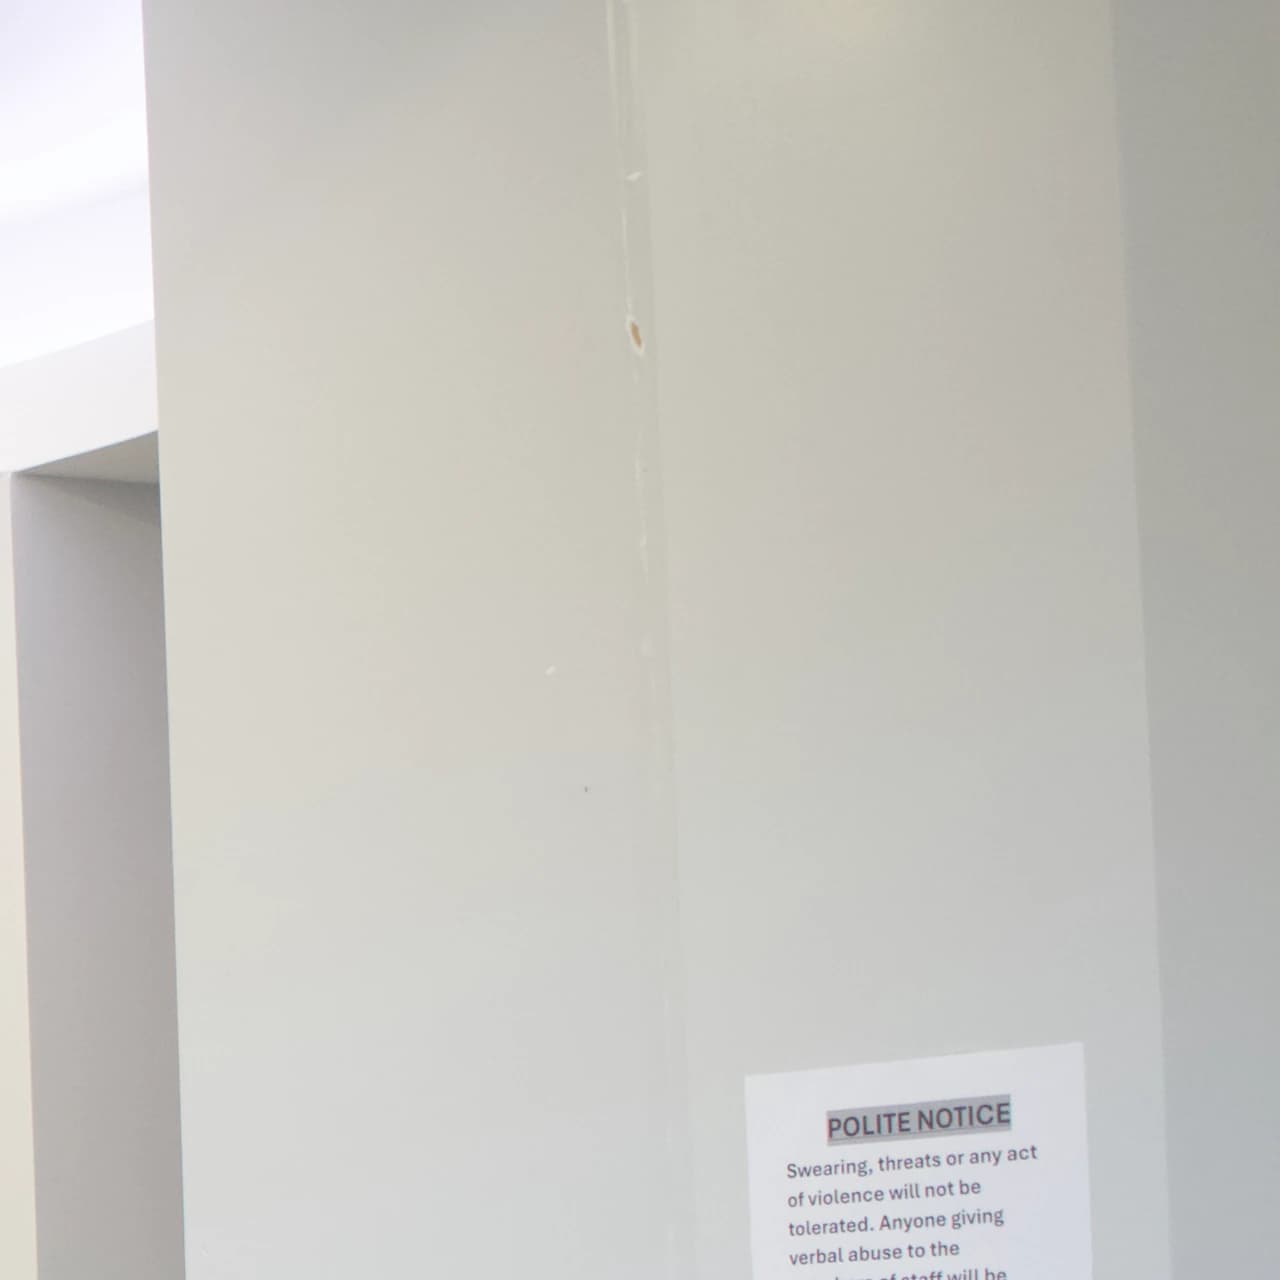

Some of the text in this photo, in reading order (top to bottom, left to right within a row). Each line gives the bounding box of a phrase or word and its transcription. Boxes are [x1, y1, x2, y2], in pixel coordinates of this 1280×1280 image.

[827, 1101, 1011, 1139] POLITE NOTICE
[786, 1145, 1038, 1179] Swearing, threats or any act
[787, 1179, 982, 1208] of violence will not be
[788, 1208, 1004, 1237] tolerated. Anyone giving
[789, 1240, 961, 1266] verbal abuse to the
